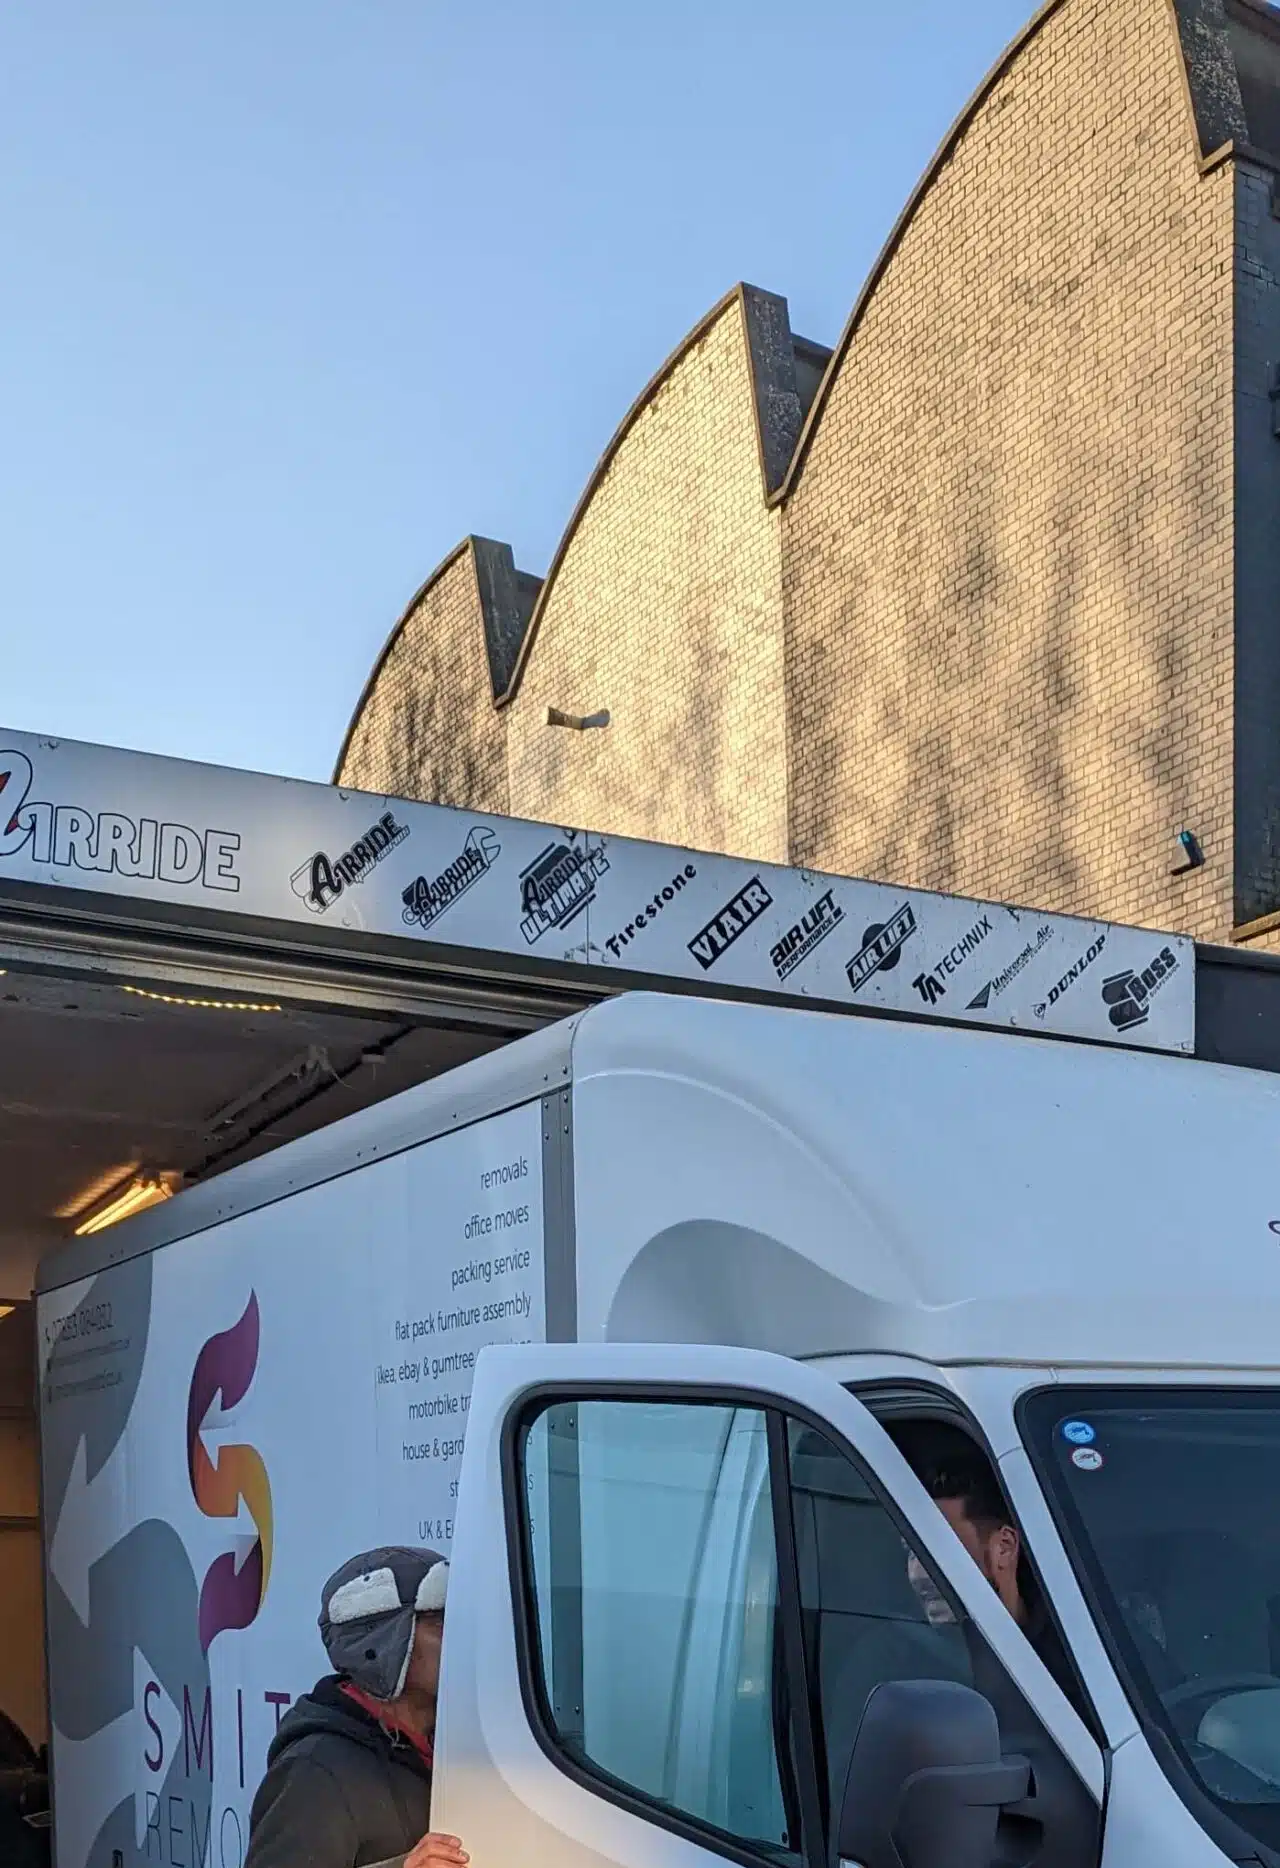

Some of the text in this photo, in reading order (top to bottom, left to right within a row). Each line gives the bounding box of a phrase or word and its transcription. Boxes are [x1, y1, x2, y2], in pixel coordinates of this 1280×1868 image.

[311, 811, 400, 908] AIRRIDE
[411, 847, 480, 915] AIRRIDE
[522, 845, 588, 913] AIRRIDE
[520, 847, 611, 945] ULTIMATE
[605, 863, 697, 958] Firestone
[690, 882, 771, 963] VIAIR
[801, 888, 836, 934] LIFT
[851, 908, 915, 984] AIR LIFT
[934, 914, 994, 981] TECHNIX
[1047, 934, 1106, 1006] DUNLOP
[1127, 946, 1177, 1003] BOSS
[481, 1155, 528, 1190] removals
[464, 1205, 529, 1239] office moves
[452, 1248, 530, 1291] packing service
[395, 1290, 531, 1342] flat pack furniture assembly
[399, 1359, 420, 1383] ebay
[423, 1356, 430, 1377] &
[431, 1351, 474, 1380] gumtree
[409, 1393, 457, 1421] motorbike
[403, 1441, 430, 1460] house
[433, 1438, 440, 1457] &
[419, 1520, 433, 1540] UK
[436, 1520, 443, 1539] &
